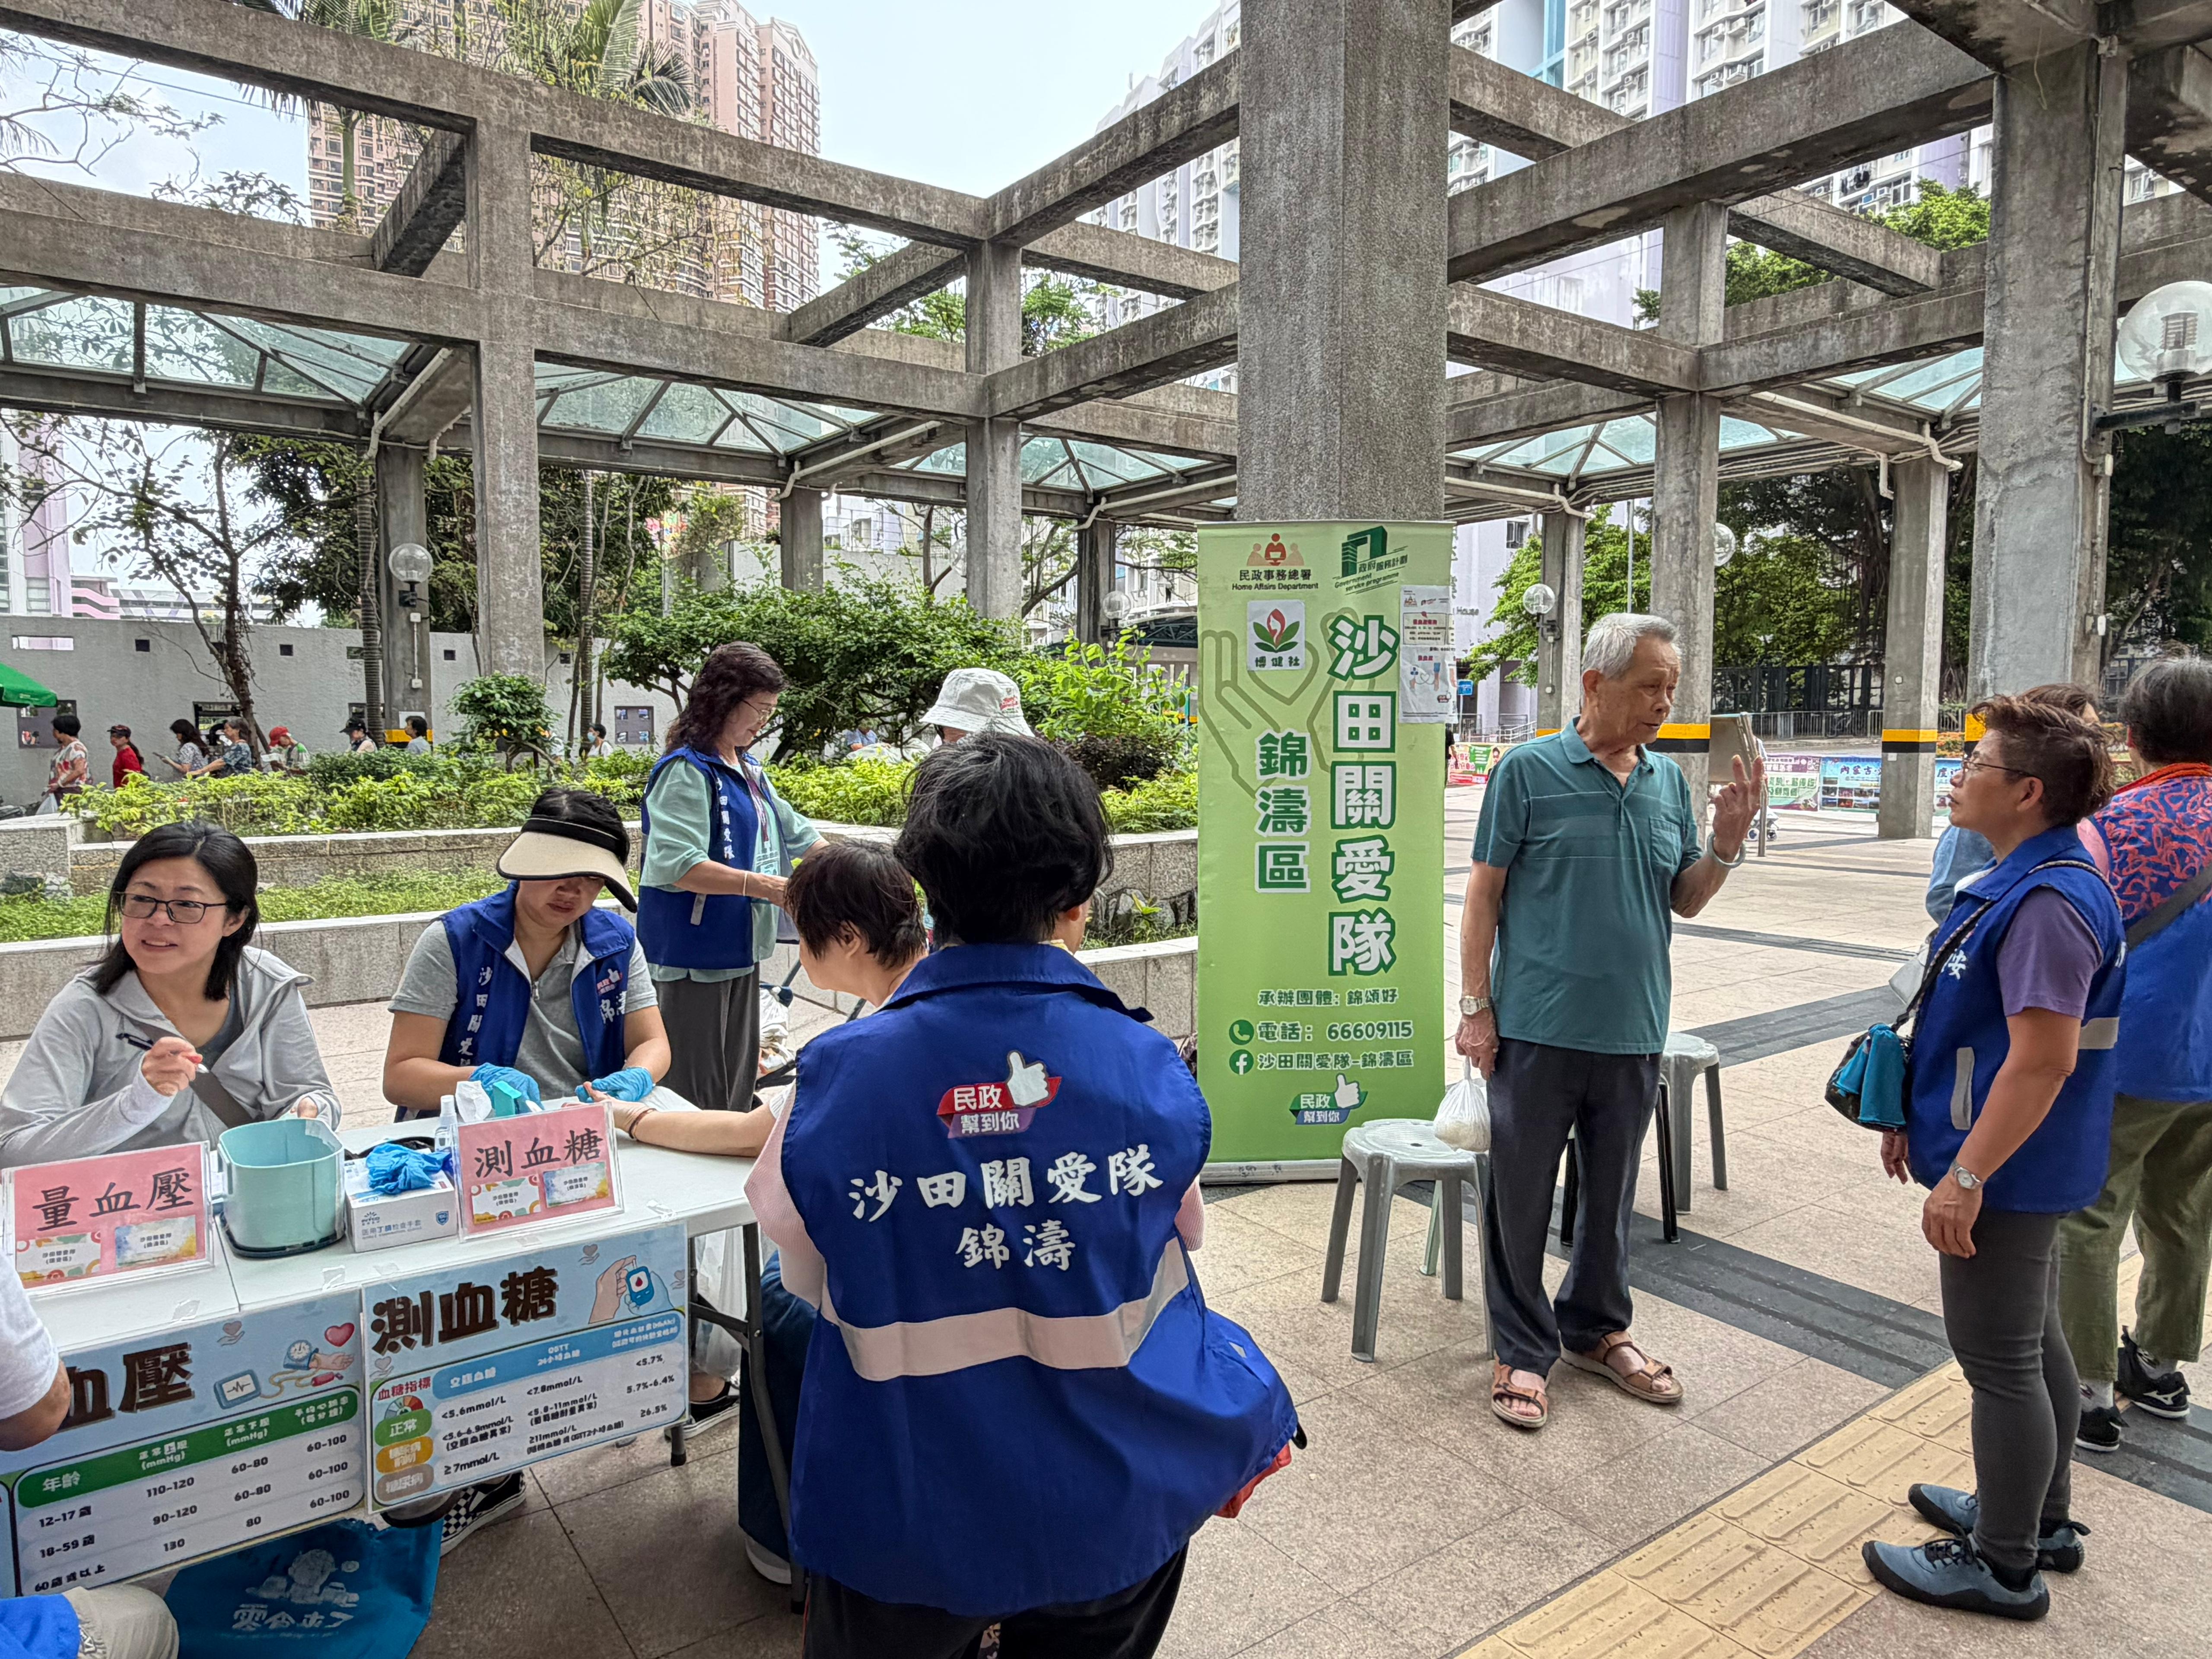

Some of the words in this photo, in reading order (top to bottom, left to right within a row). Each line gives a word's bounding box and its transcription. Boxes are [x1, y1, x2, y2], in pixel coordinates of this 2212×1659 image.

[1239, 569, 1312, 581] 民政事務總署
[1335, 572, 1372, 588] Government
[1328, 615, 1400, 976] 沙田關愛隊
[1257, 730, 1309, 891] 錦濤區
[1327, 1020, 1413, 1041] 66609115
[953, 1084, 1002, 1111] 民政
[1300, 1094, 1331, 1109] 民政
[960, 1111, 1020, 1134] 幫到你
[1303, 1110, 1340, 1123] 幫到你
[474, 1128, 603, 1178] 測血糖
[848, 1144, 1164, 1222] 沙田關愛隊
[32, 1167, 194, 1232] 量血壓
[956, 1219, 1076, 1271] 錦濤
[371, 1265, 558, 1356] 測血糖
[378, 1376, 431, 1401] 血糖指標
[527, 1376, 583, 1395] <7.8mmol/L
[626, 1375, 675, 1394] 5.7%-6.4%
[442, 1396, 506, 1418] <5.6mmol/L
[226, 1427, 268, 1447] (mmHg)
[389, 1418, 417, 1438] 正常
[307, 1434, 346, 1452] 60-100
[141, 1450, 185, 1470] (mmHg)
[231, 1457, 268, 1474] 60-80
[42, 1471, 81, 1491] 年齡
[308, 1462, 348, 1480] 60-100
[146, 1477, 194, 1497] 110-120
[234, 1484, 271, 1501] 60-80
[310, 1490, 350, 1508] 60-100
[153, 1505, 197, 1525] 90-120
[246, 1516, 261, 1527] 80
[163, 1538, 185, 1551] 130
